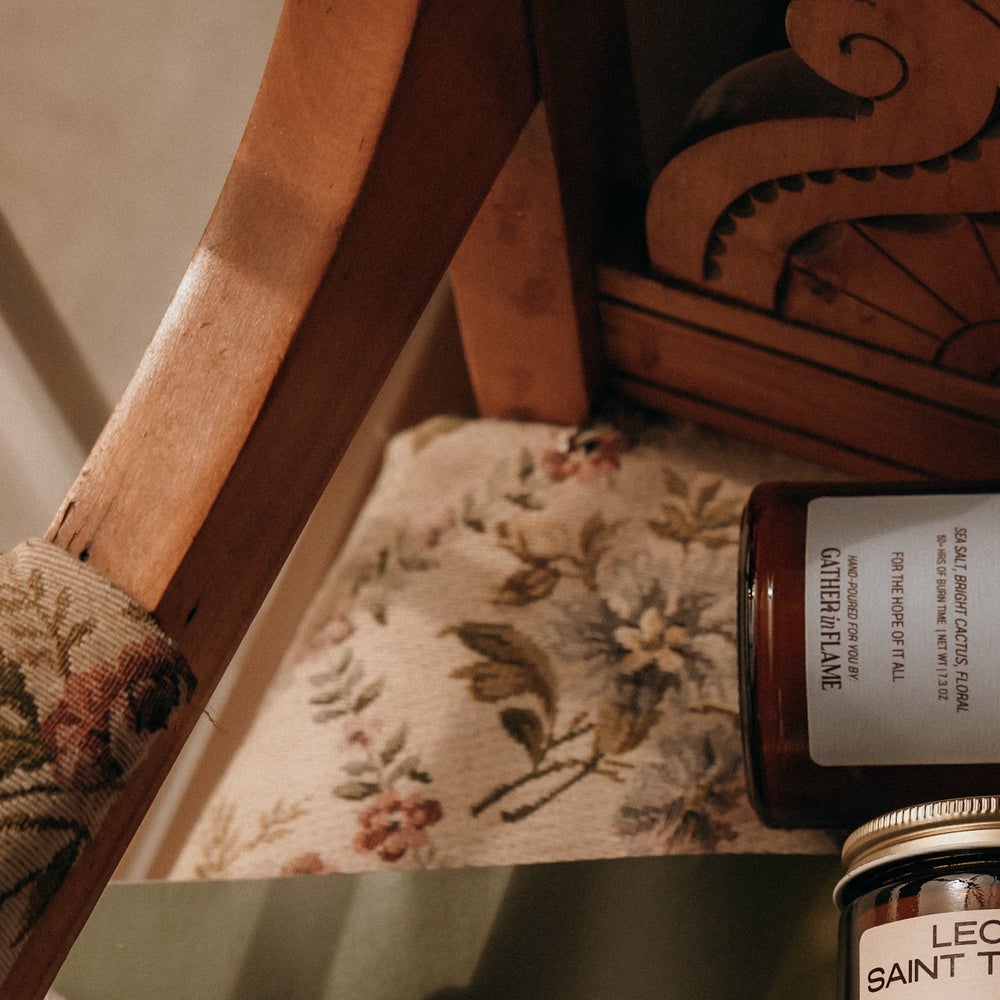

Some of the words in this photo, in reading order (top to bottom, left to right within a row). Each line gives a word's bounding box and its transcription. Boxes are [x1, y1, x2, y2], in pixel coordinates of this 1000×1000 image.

[954, 527, 967, 543] SEA
[891, 551, 904, 571] FOR
[937, 549, 946, 564] HRS
[952, 544, 967, 571] SALT,
[937, 567, 946, 576] OF
[848, 555, 858, 620] HAND-POURED
[891, 573, 904, 593] THE
[936, 578, 947, 603] BURN
[954, 575, 967, 616] BRIGHT
[891, 596, 904, 628] HOPE
[936, 605, 947, 624] TIME
[848, 622, 858, 645] FOR
[892, 630, 904, 644] OF
[936, 635, 947, 650] NET
[953, 619, 968, 667] CACTUS,
[848, 646, 858, 663] YOU
[892, 647, 904, 657] IT
[936, 652, 948, 664] WT
[848, 665, 859, 682] BY:
[892, 660, 904, 682] ALL
[938, 689, 948, 701] OZ
[955, 670, 969, 713] FLORAL
[867, 953, 964, 992] SAINT
